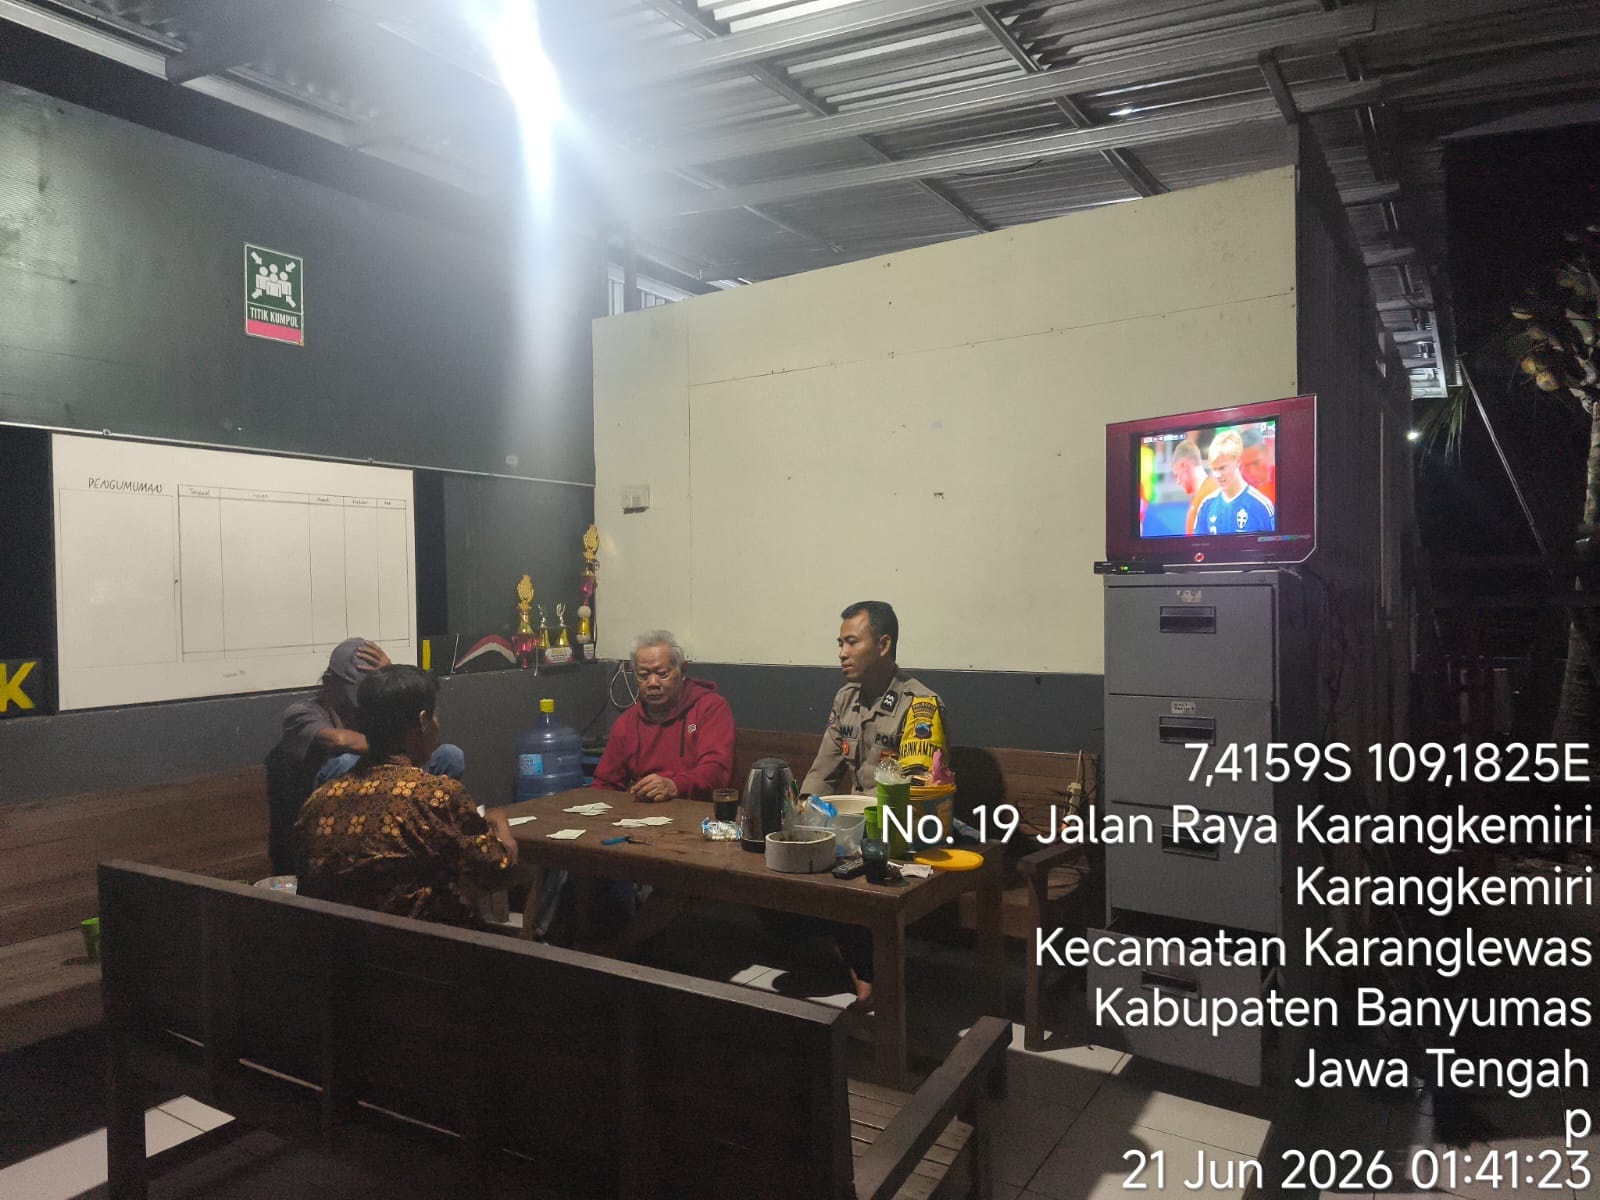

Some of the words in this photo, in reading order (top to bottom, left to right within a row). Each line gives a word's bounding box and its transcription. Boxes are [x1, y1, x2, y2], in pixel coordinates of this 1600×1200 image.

[249, 307, 269, 322] TITIK
[270, 311, 299, 328] KUMPUL
[88, 477, 163, 493] PENGUMUMAN
